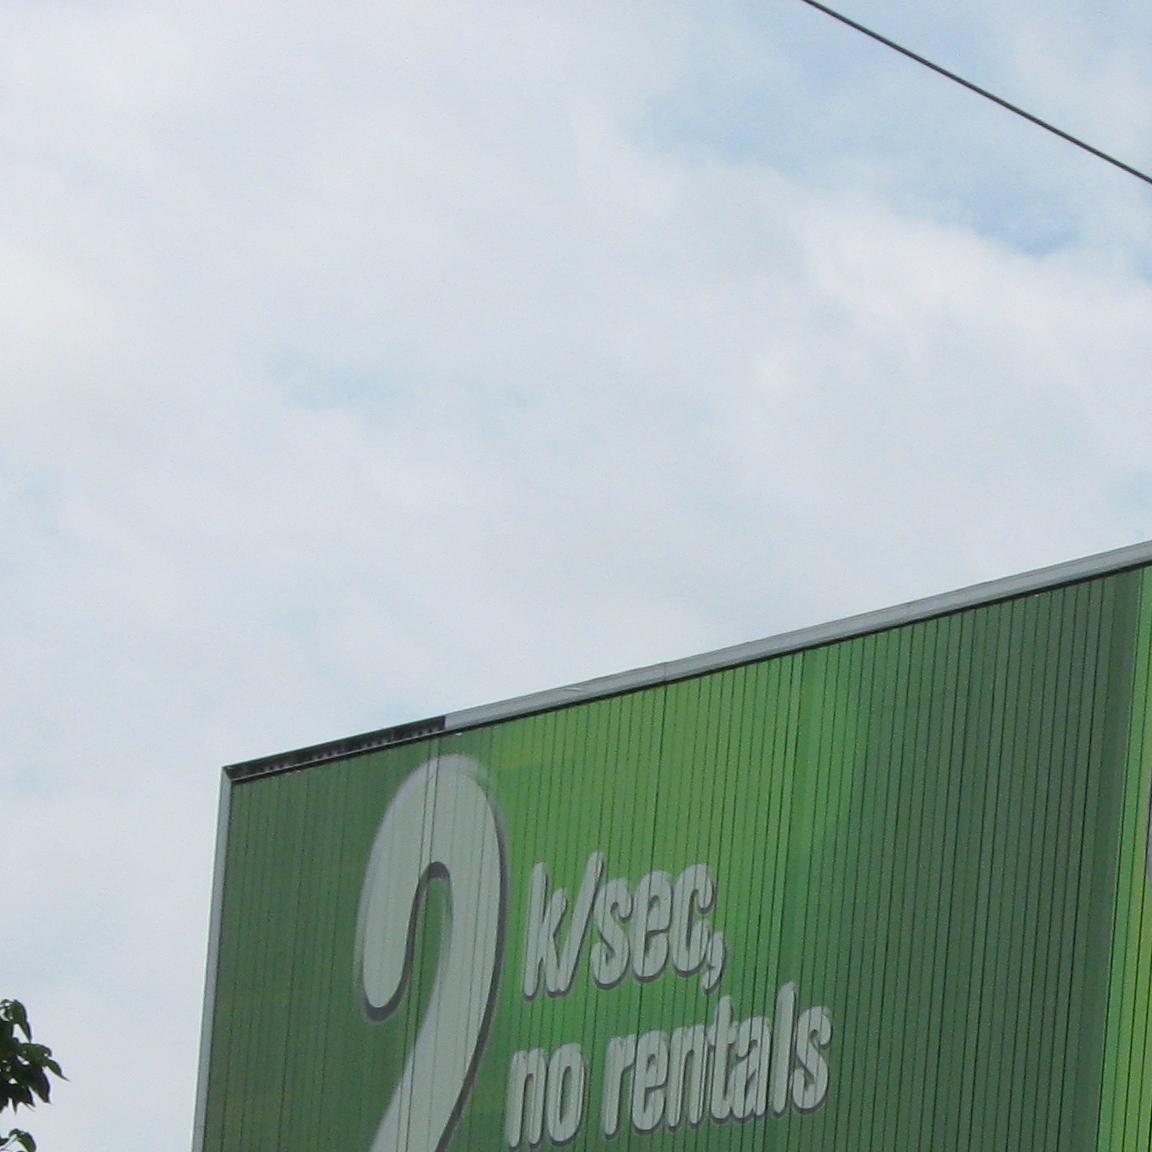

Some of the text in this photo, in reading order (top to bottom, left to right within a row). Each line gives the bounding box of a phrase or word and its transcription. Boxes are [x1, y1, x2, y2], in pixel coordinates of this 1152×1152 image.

[522, 851, 728, 994] k/sec,
[507, 981, 832, 1149] no rentals
